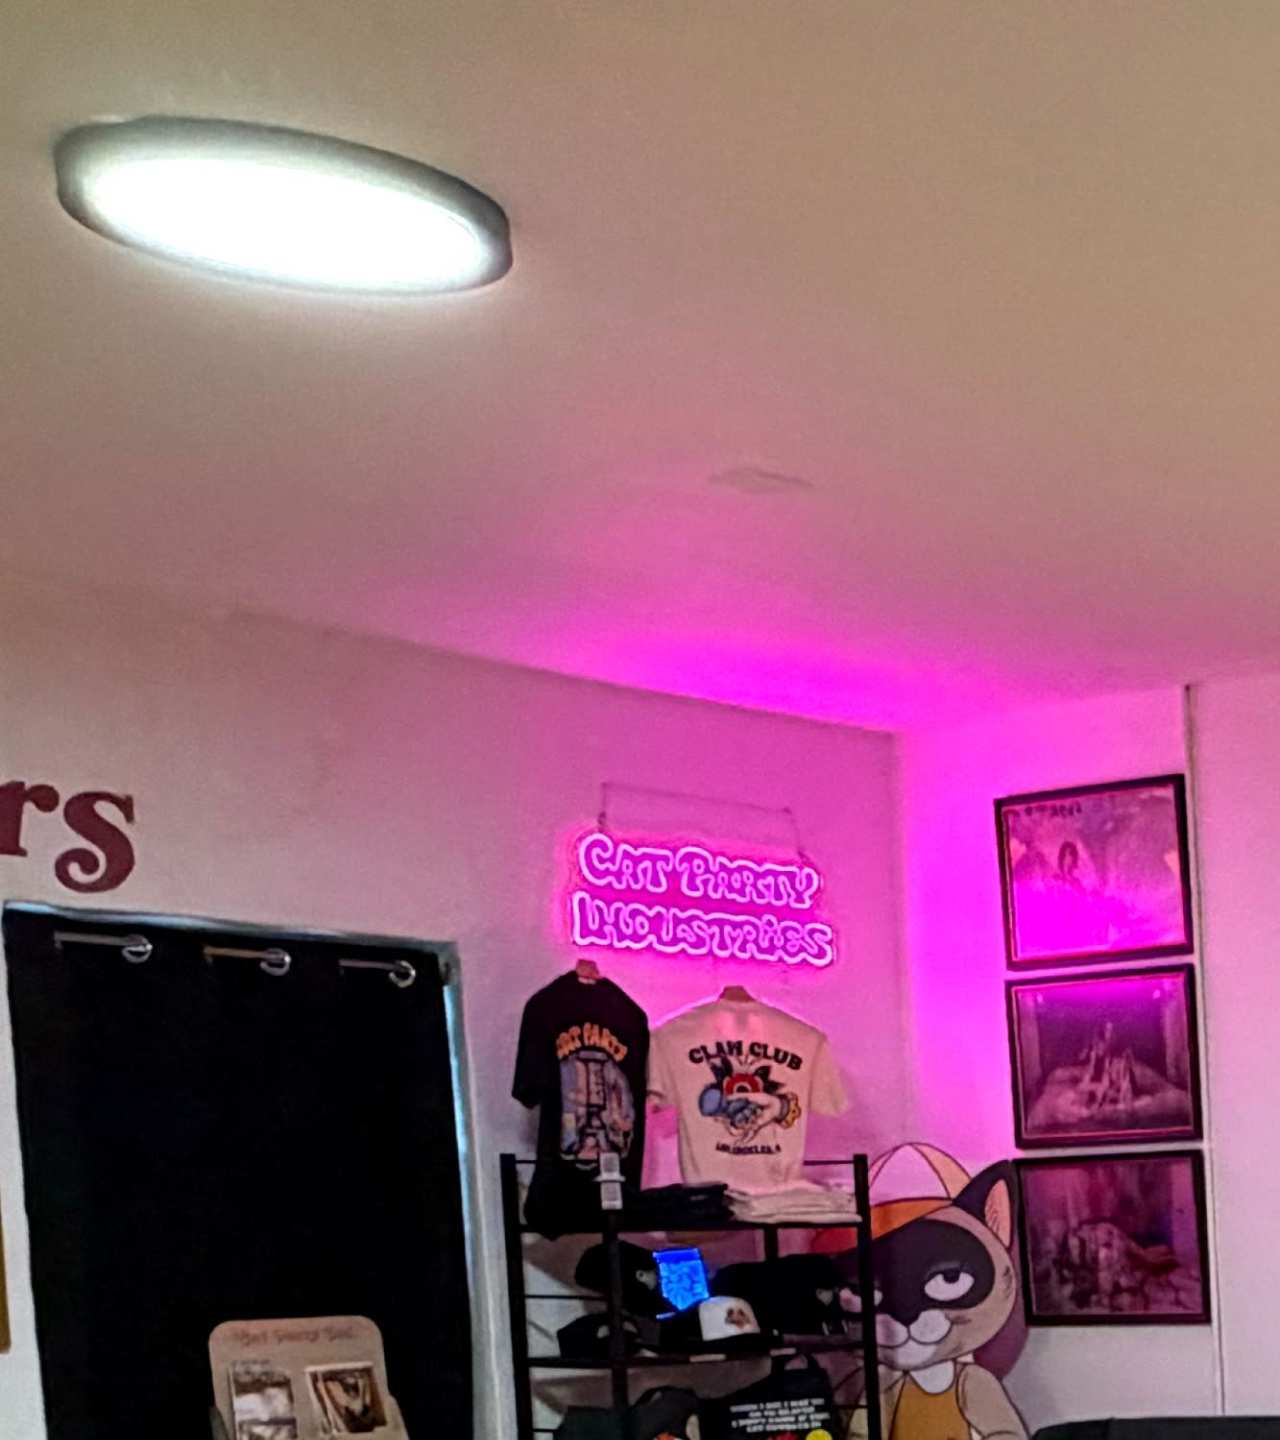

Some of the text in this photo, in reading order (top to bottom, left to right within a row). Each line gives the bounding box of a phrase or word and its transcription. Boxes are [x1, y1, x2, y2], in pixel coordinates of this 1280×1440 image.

[579, 833, 820, 909] CAT PARTY
[688, 1040, 803, 1070] CLAW CLUB
